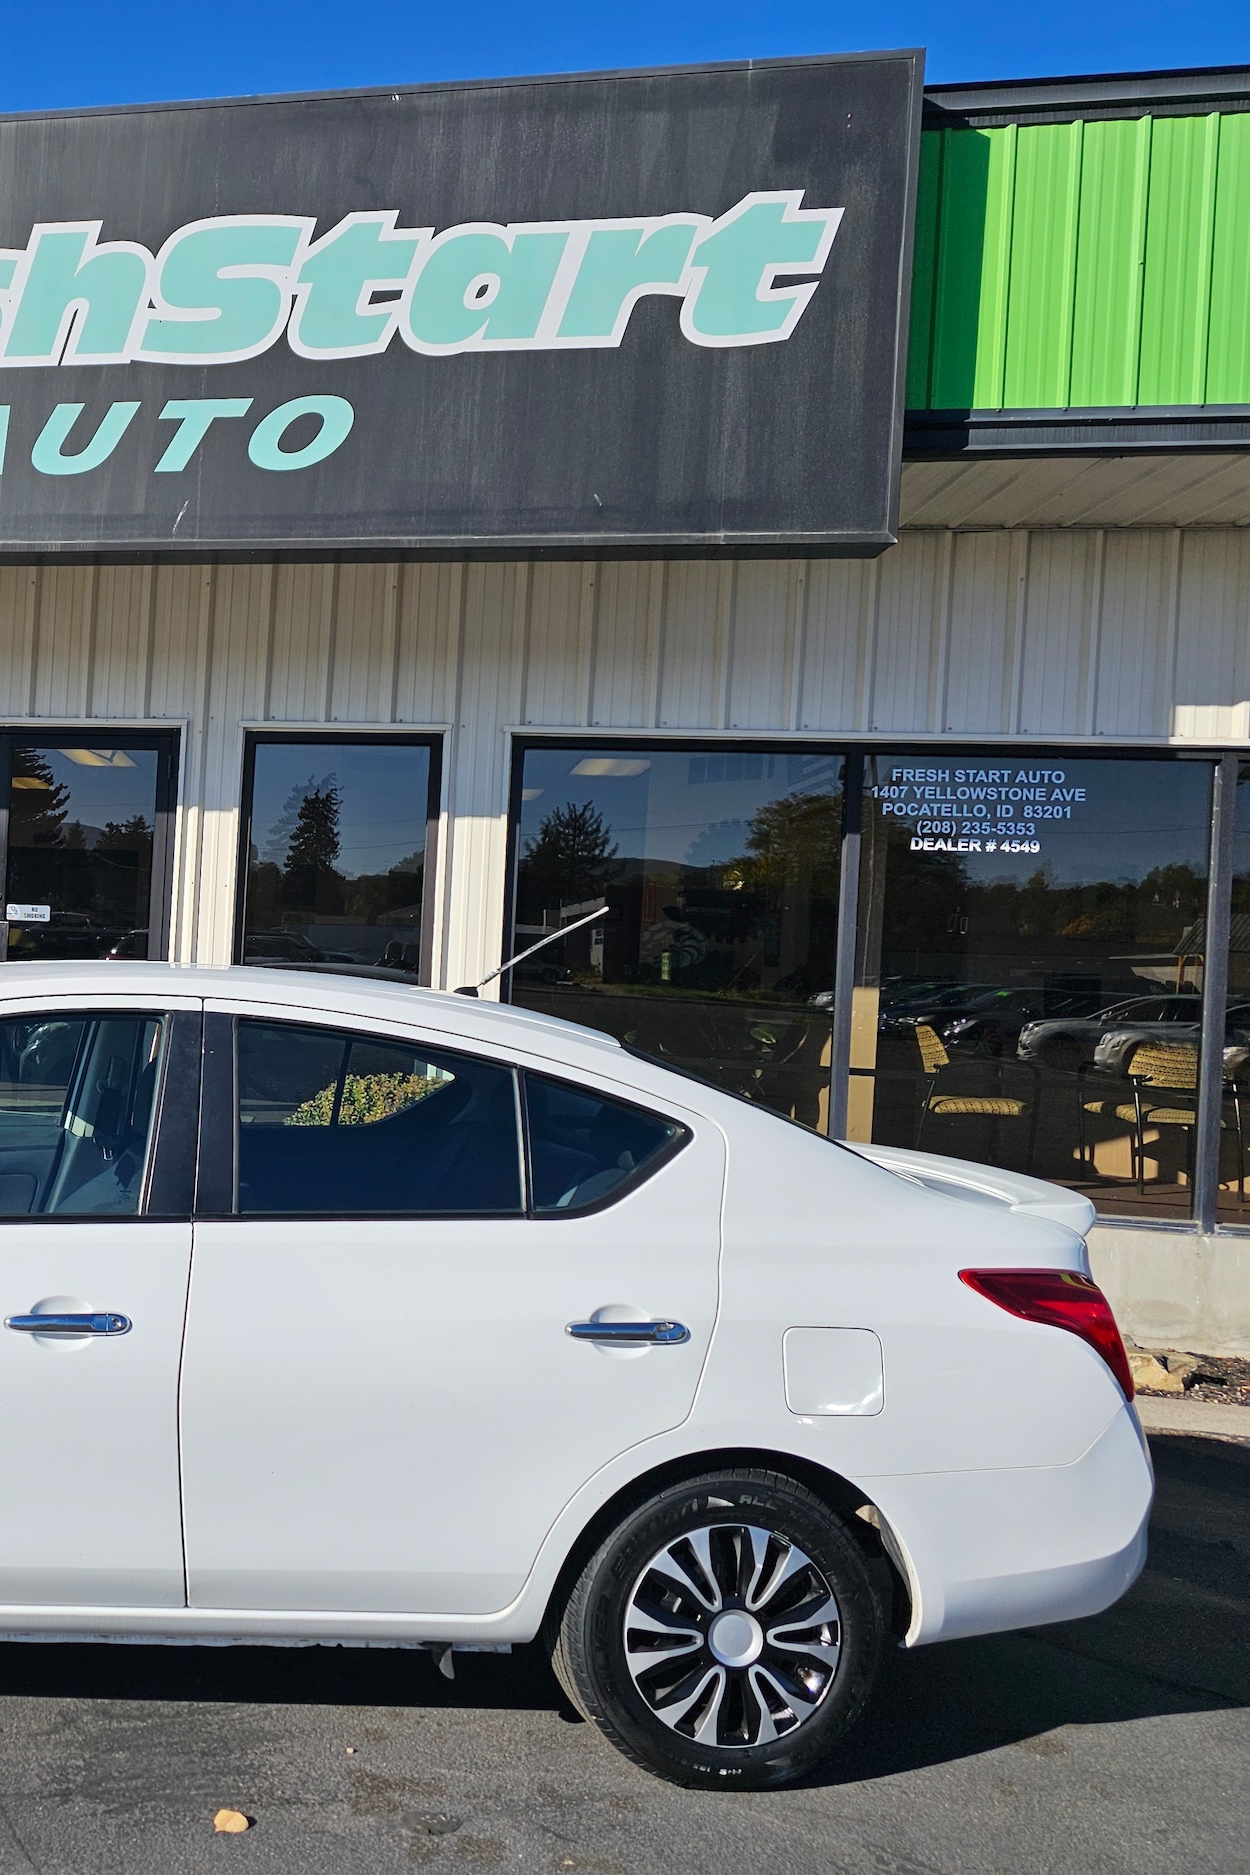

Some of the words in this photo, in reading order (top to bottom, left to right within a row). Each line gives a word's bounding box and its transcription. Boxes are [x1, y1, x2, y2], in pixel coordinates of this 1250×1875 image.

[892, 768, 950, 782] FRESH
[954, 769, 1012, 784] START
[1015, 770, 1065, 784] AUTO
[871, 786, 908, 799] 1407
[913, 786, 1047, 801] YELLOWSTONE
[1050, 788, 1086, 802] AVE
[882, 802, 991, 819] POCATELLO,
[996, 804, 1014, 818] ID
[1023, 804, 1072, 819] 83201
[916, 820, 957, 836] (208)
[961, 821, 1036, 836] 235-5353
[910, 837, 981, 852] DEALER
[985, 839, 997, 852] #
[999, 839, 1040, 854] 4549
[739, 1494, 778, 1510] ALL
